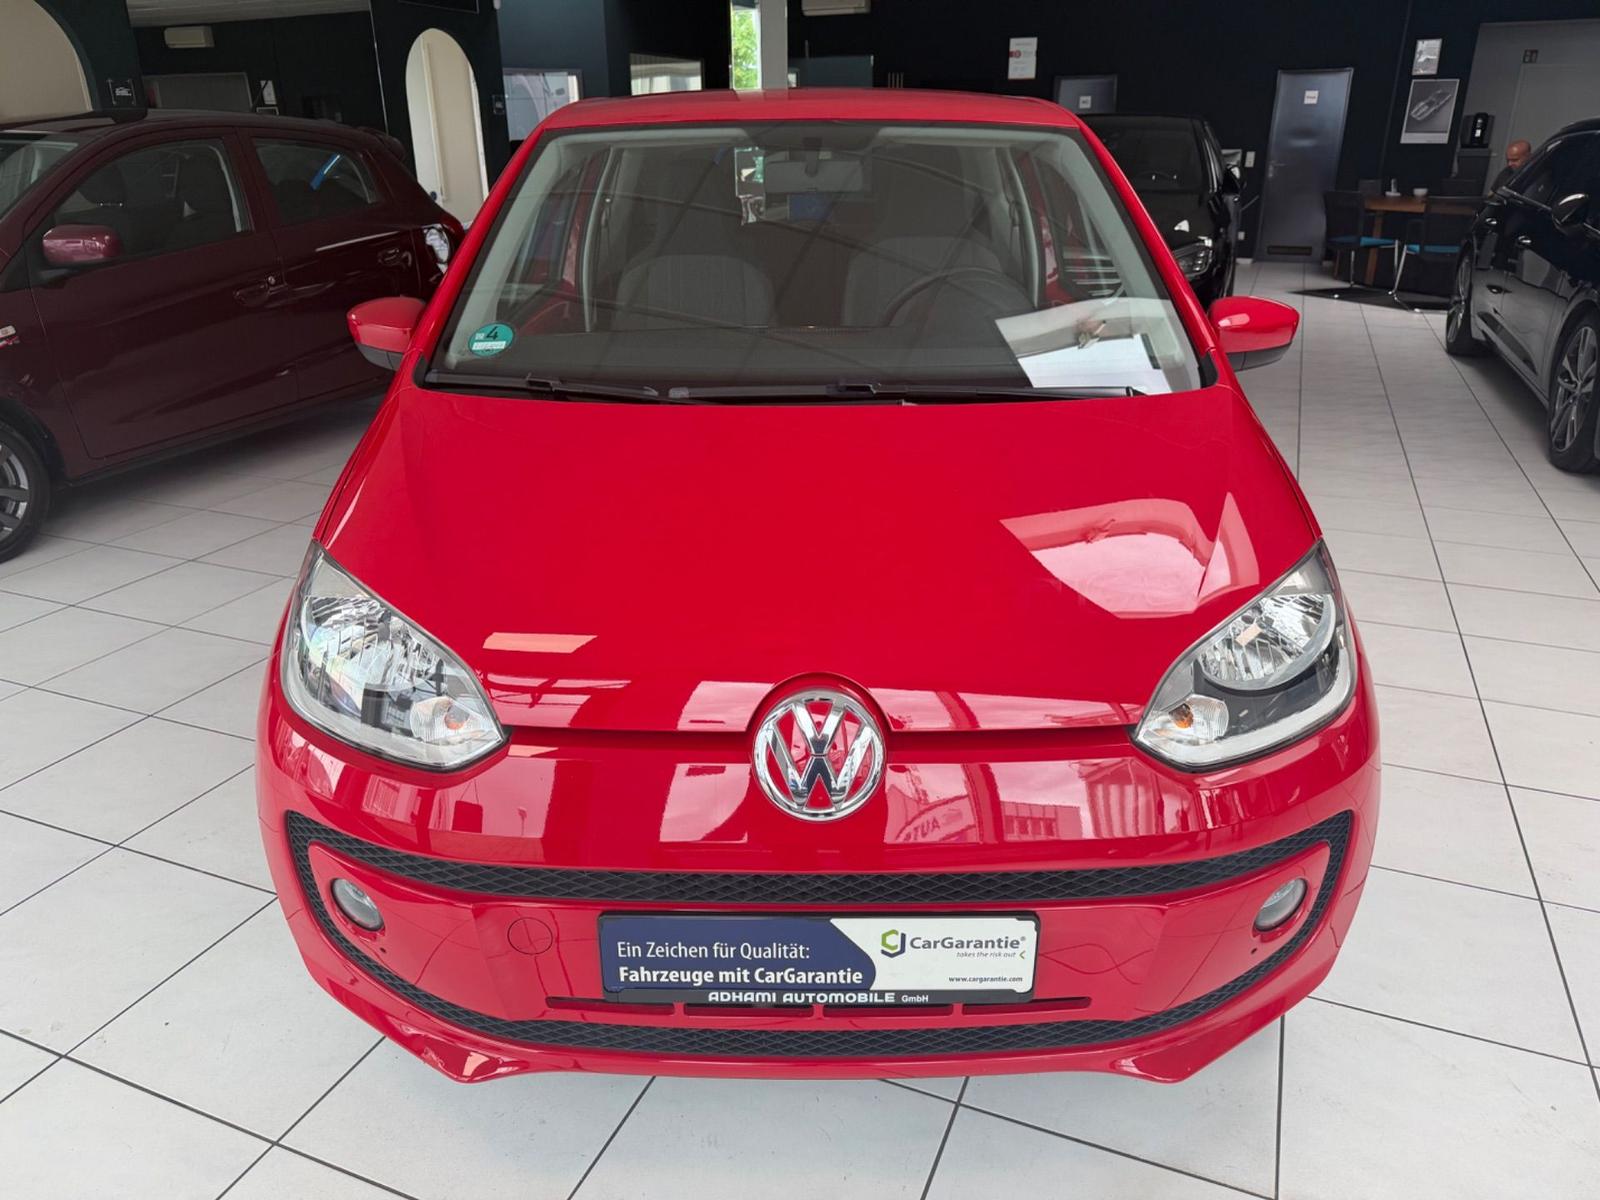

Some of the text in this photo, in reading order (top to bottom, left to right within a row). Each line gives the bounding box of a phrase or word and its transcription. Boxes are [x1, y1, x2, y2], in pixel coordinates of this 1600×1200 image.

[486, 326, 498, 340] 4
[753, 689, 885, 822] VW
[617, 941, 810, 960] Ein Zeichen für Qualität:
[619, 966, 863, 986] Fahrzeuge mit CarGarantie
[708, 991, 929, 1004] ADHAMI AUTOMOBILE GmbH
